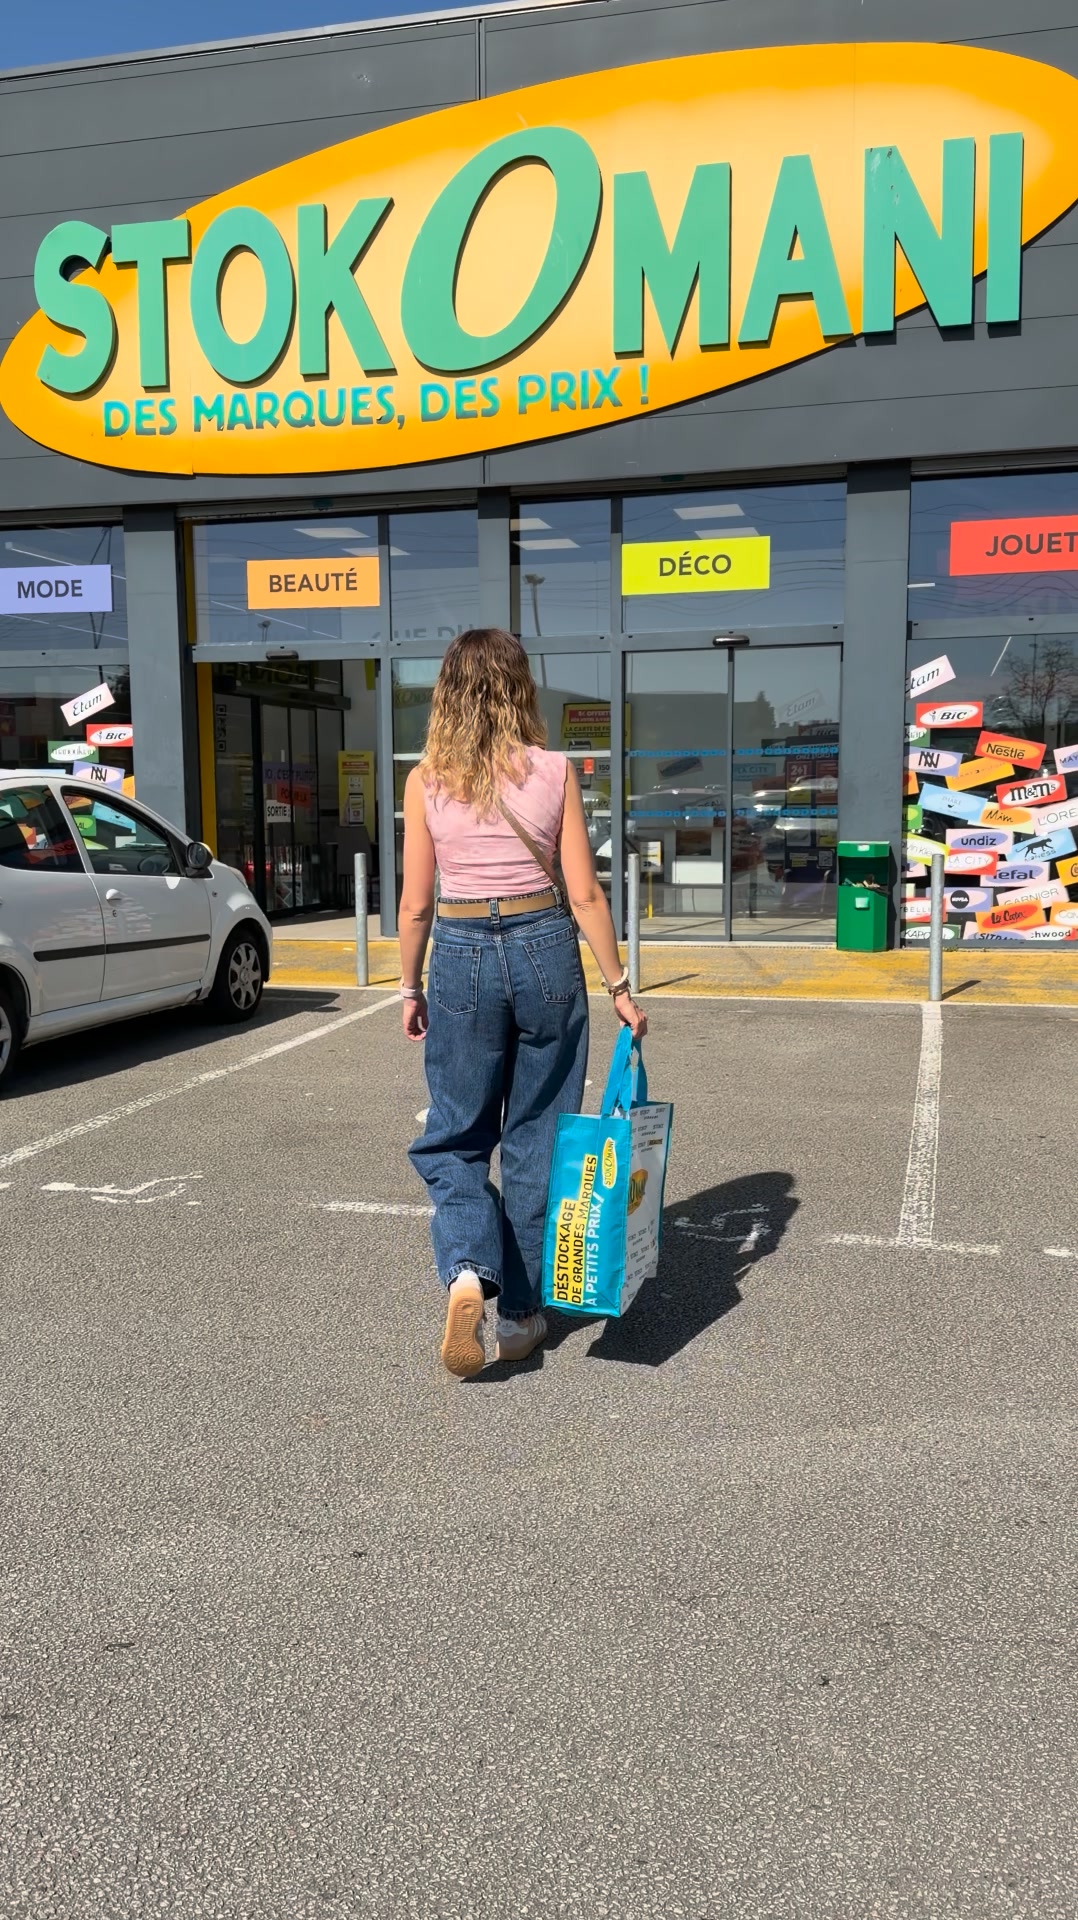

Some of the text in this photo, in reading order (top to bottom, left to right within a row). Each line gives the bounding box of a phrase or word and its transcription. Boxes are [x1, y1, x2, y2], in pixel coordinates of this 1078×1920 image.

[34, 126, 1025, 396] STOKOMANI
[103, 364, 649, 437] DES MARQUES, DES PRIX !
[659, 551, 732, 577] DÉCO
[17, 579, 83, 600] MODE
[269, 567, 358, 593] BEAUTÉ
[73, 694, 102, 717] Etam
[267, 806, 287, 817] SORTIE
[961, 835, 996, 846] undiz
[965, 855, 991, 865] CITY
[604, 1141, 615, 1186] STOKOMANI
[571, 1156, 597, 1304] DE GRANDES MARQUES
[585, 1243, 599, 1295] PETITS
